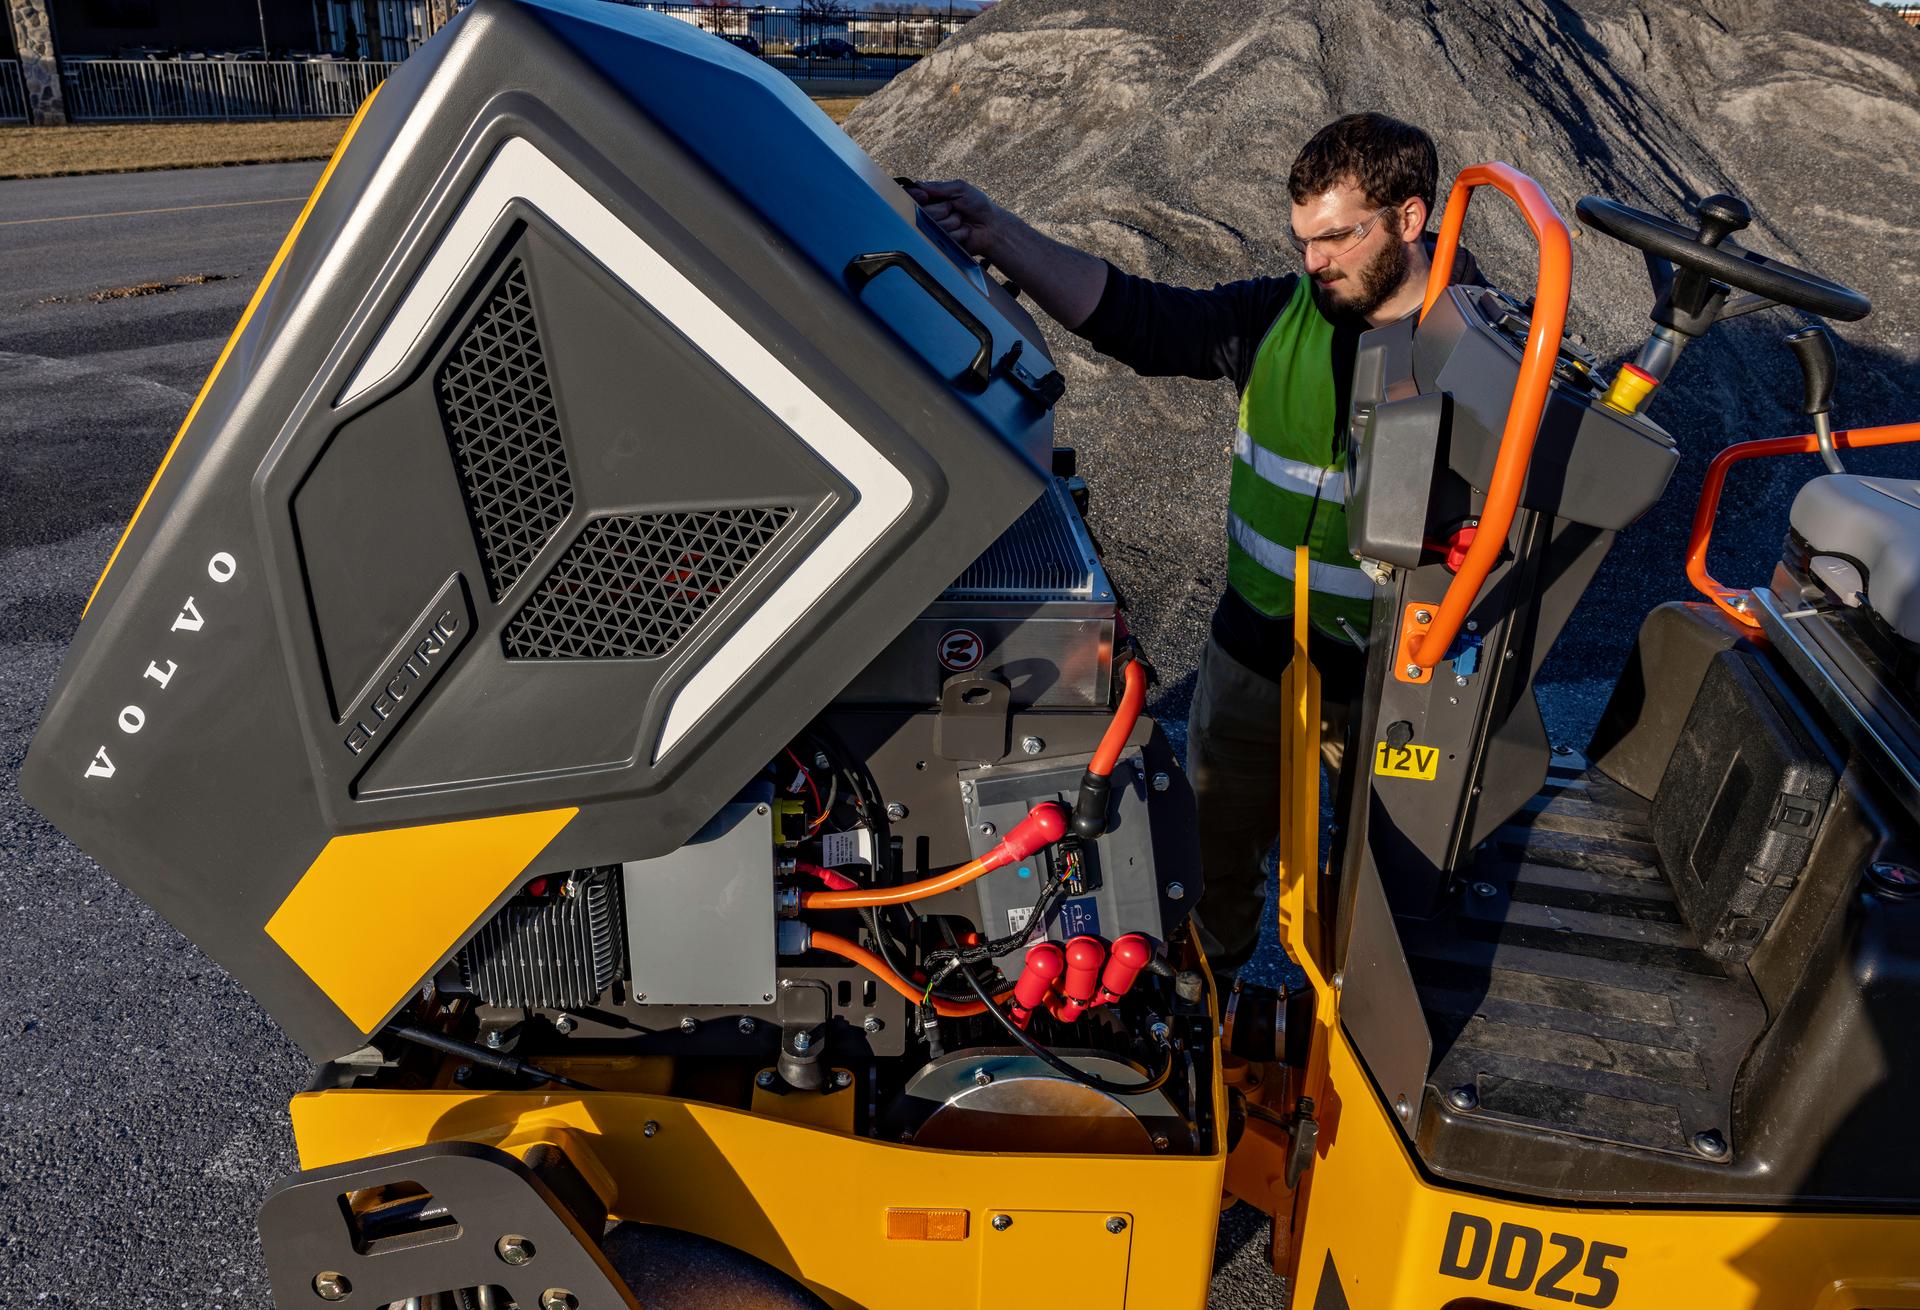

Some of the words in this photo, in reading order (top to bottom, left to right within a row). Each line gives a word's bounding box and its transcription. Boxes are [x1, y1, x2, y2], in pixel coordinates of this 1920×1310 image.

[83, 551, 237, 779] VOLVO
[344, 610, 460, 757] ELECTRIC
[1380, 747, 1435, 773] 12V
[1438, 1211, 1628, 1309] DD25
